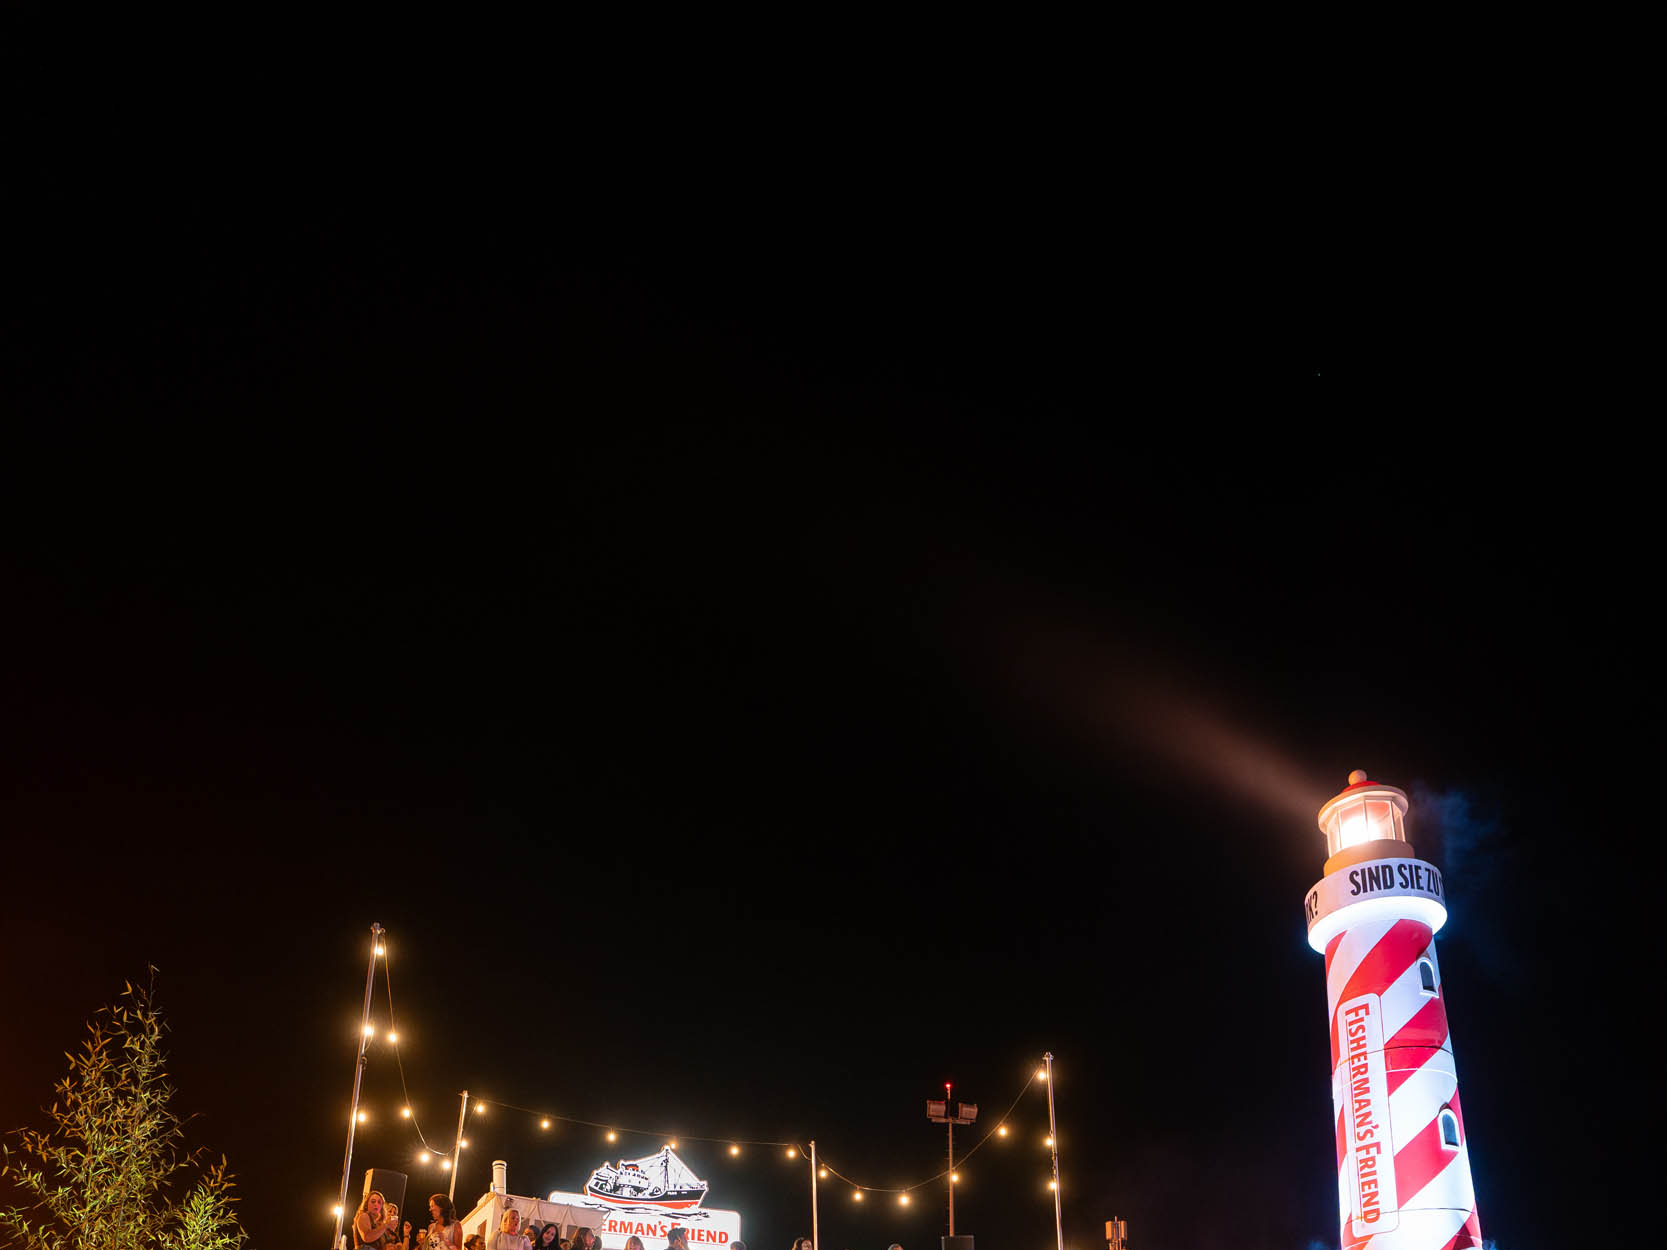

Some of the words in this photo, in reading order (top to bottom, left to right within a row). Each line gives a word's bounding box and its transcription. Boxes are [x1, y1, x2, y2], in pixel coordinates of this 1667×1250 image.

[1349, 864, 1395, 896] SIND
[1397, 863, 1424, 890] SIE
[1344, 1003, 1380, 1142] FISHERMAN'S
[1355, 1141, 1381, 1224] FRIEND
